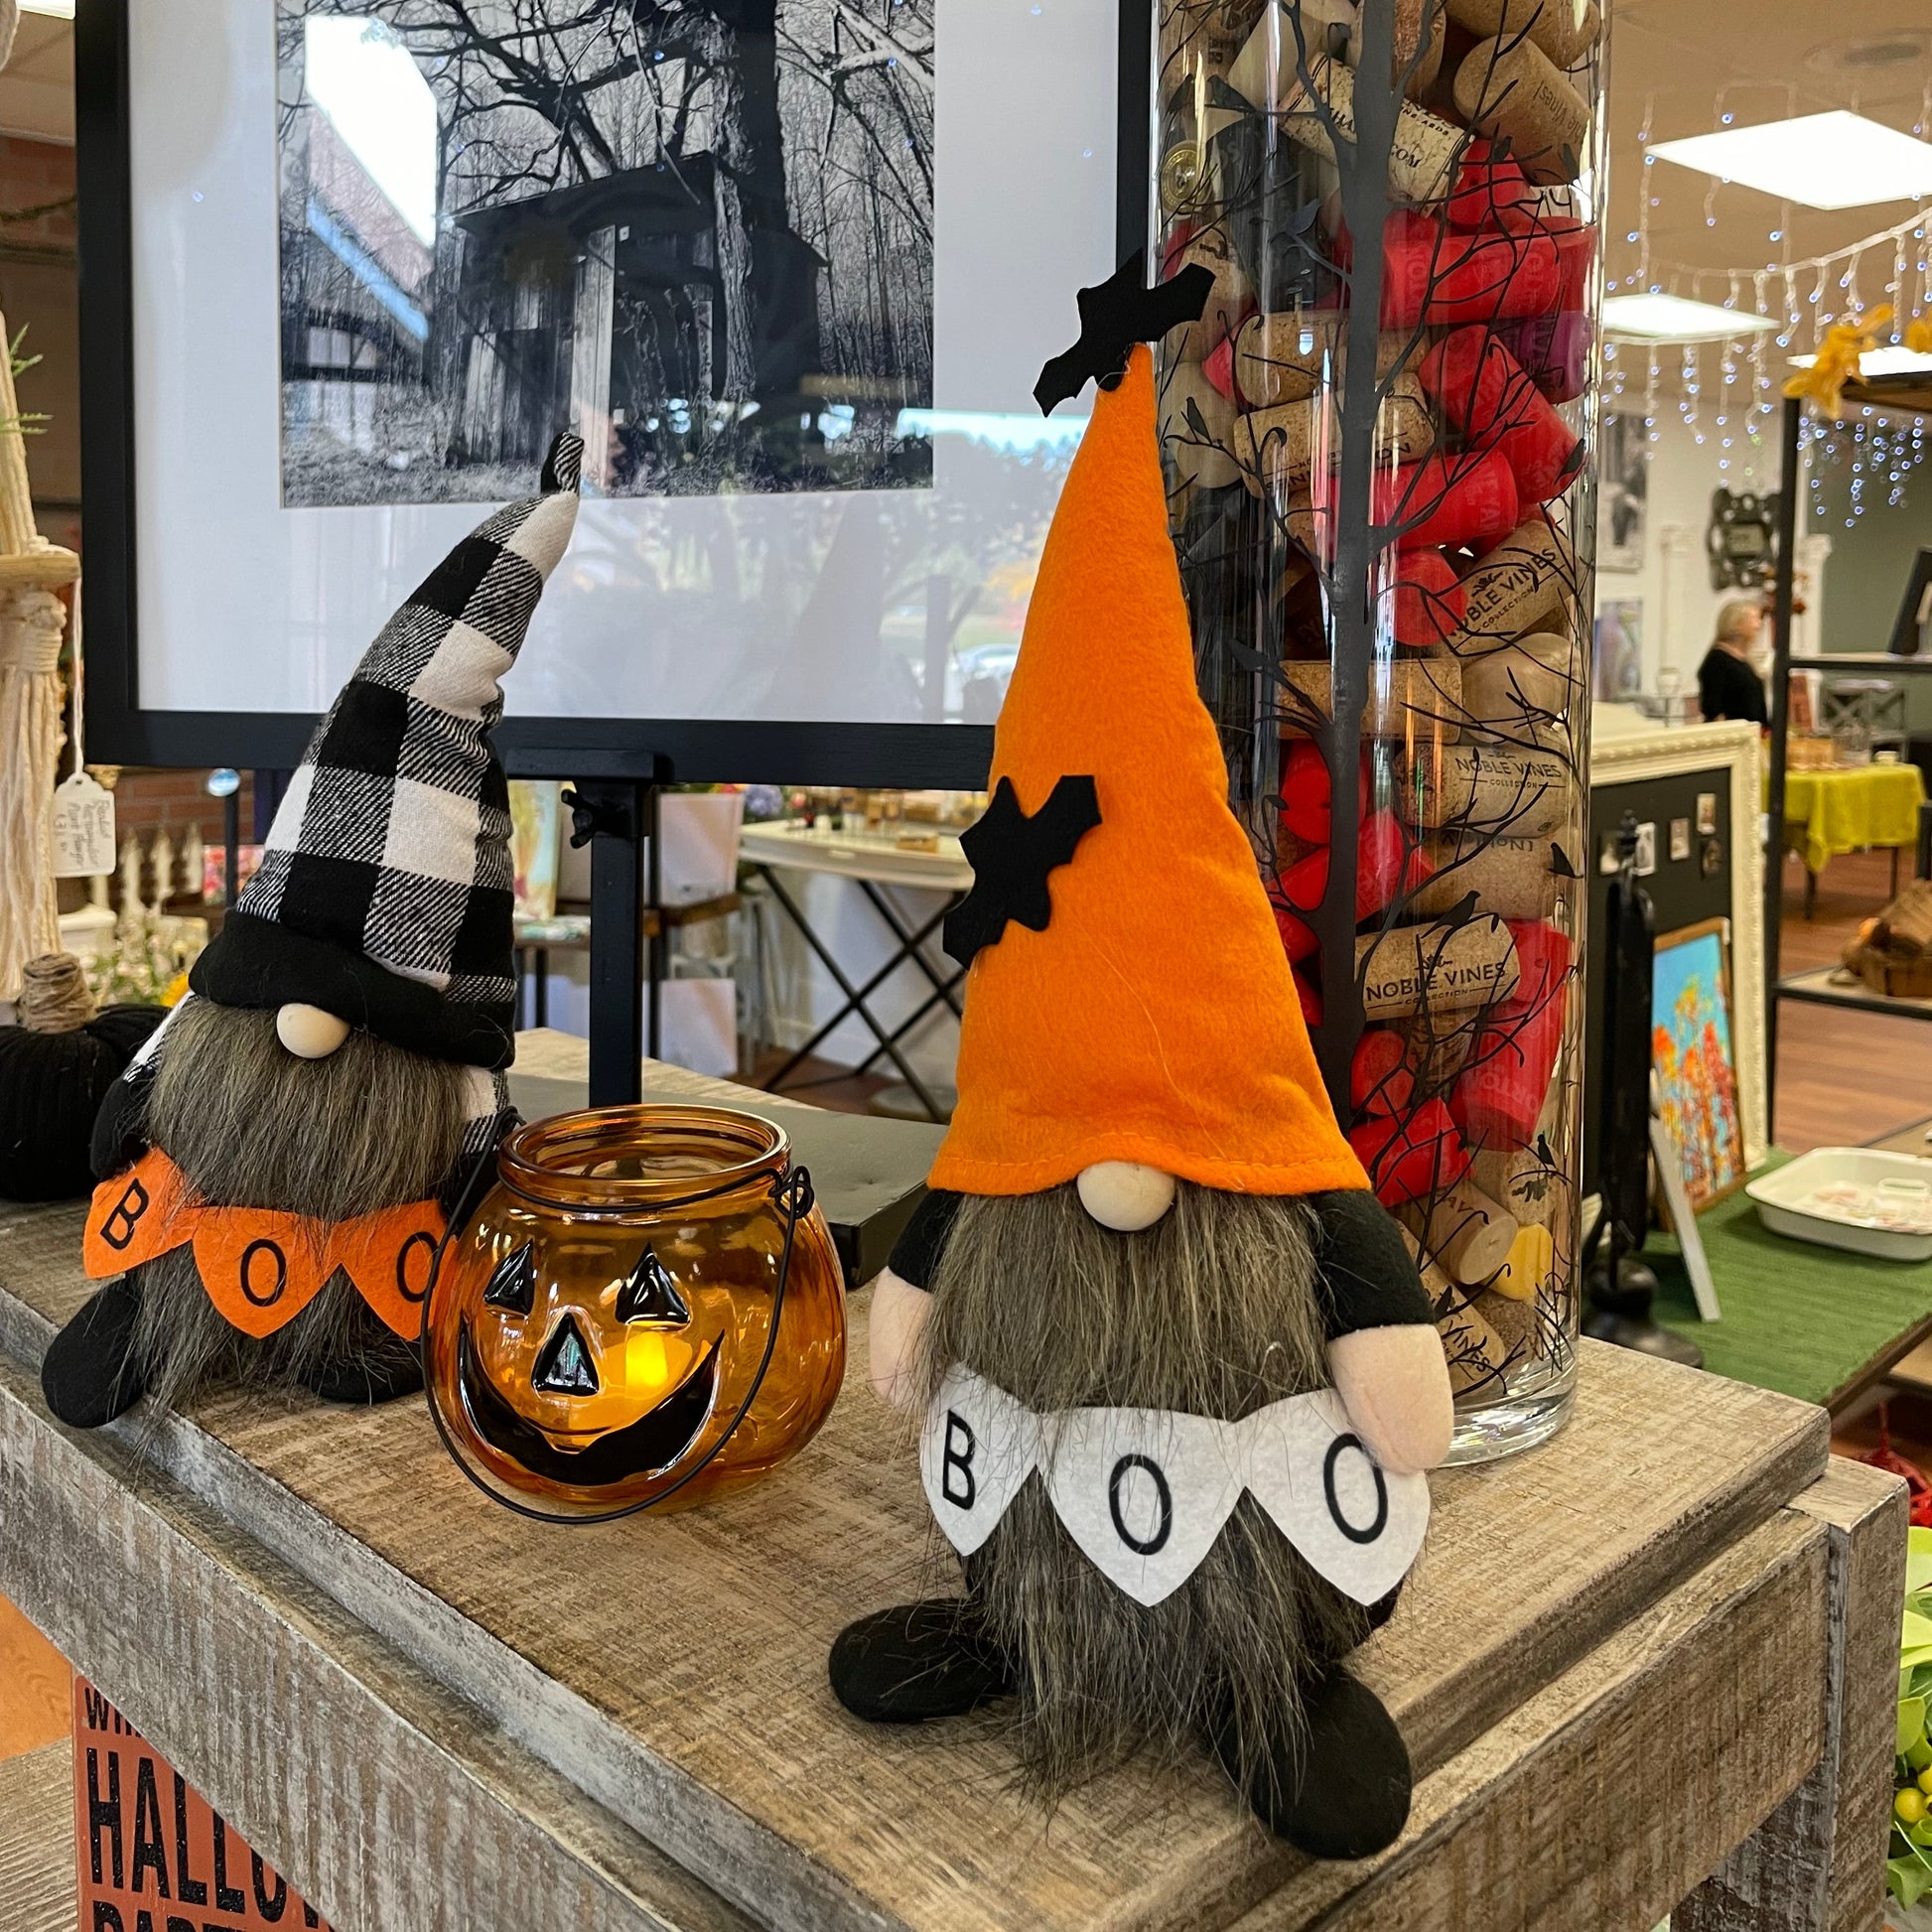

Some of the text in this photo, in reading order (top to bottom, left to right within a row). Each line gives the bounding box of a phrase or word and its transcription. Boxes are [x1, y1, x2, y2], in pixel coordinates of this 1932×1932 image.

[1454, 758, 1512, 775] NOBLE
[1365, 961, 1507, 1003] NOBLE VINES
